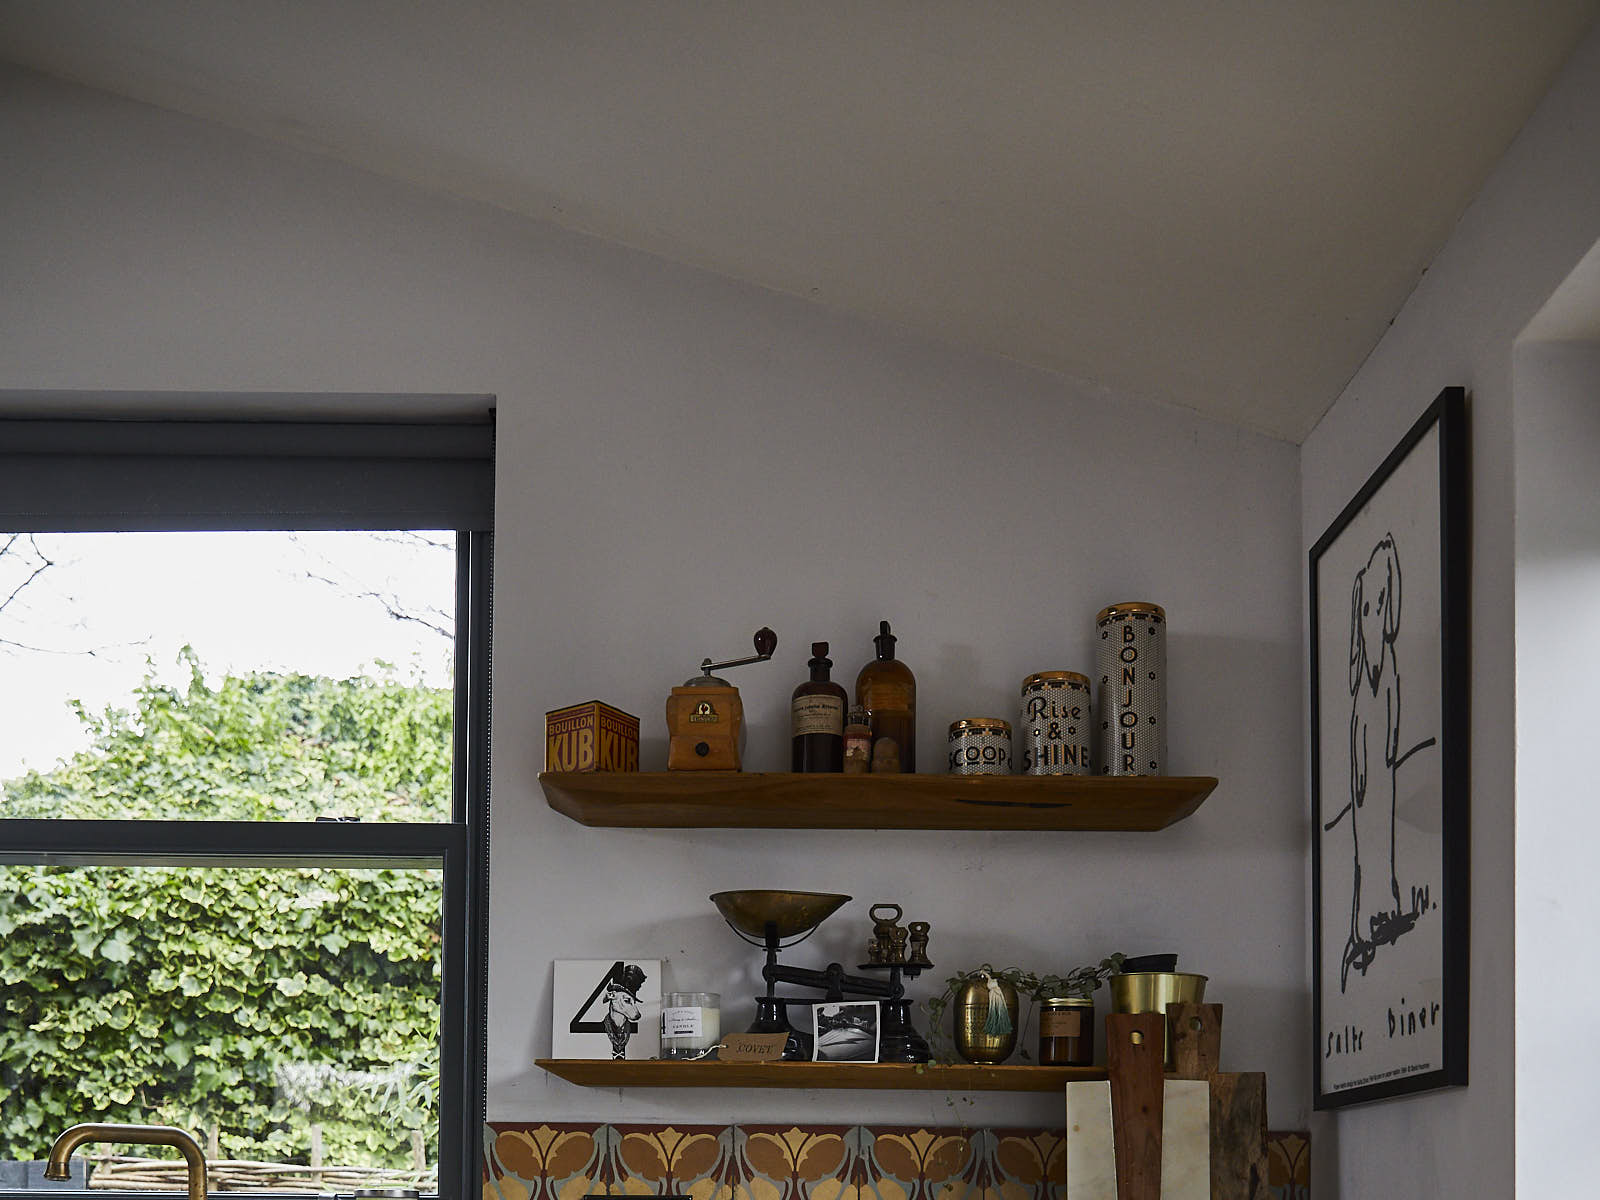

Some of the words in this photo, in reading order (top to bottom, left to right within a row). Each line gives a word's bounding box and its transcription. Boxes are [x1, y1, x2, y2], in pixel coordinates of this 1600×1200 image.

[1027, 697, 1081, 722] Rise
[1120, 625, 1139, 772] BONJOUR
[548, 715, 593, 735] BOUILLON
[600, 716, 638, 741] BOUILLON
[1048, 722, 1062, 740] &
[548, 728, 593, 773] KUB
[600, 729, 638, 774] KUB
[1023, 744, 1089, 771] SHINE
[1387, 997, 1440, 1038] Diner
